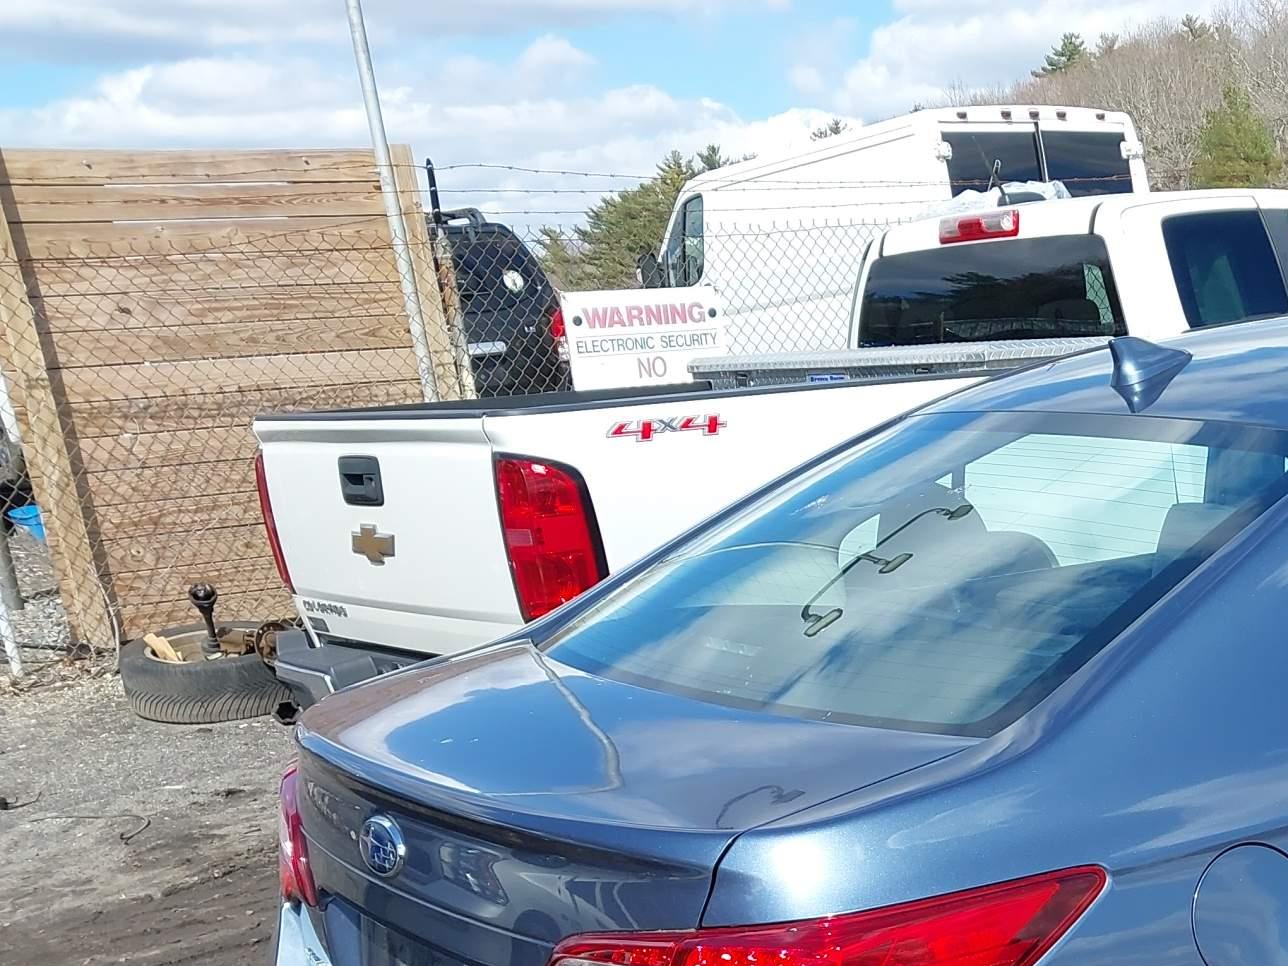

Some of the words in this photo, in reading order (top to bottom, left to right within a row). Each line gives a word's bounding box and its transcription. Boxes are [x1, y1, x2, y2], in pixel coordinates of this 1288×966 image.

[581, 302, 706, 329] WARNING
[576, 336, 655, 354] ELECTRONIC
[660, 332, 717, 349] SECURITY
[637, 356, 667, 379] NO
[606, 413, 727, 443] 4x4
